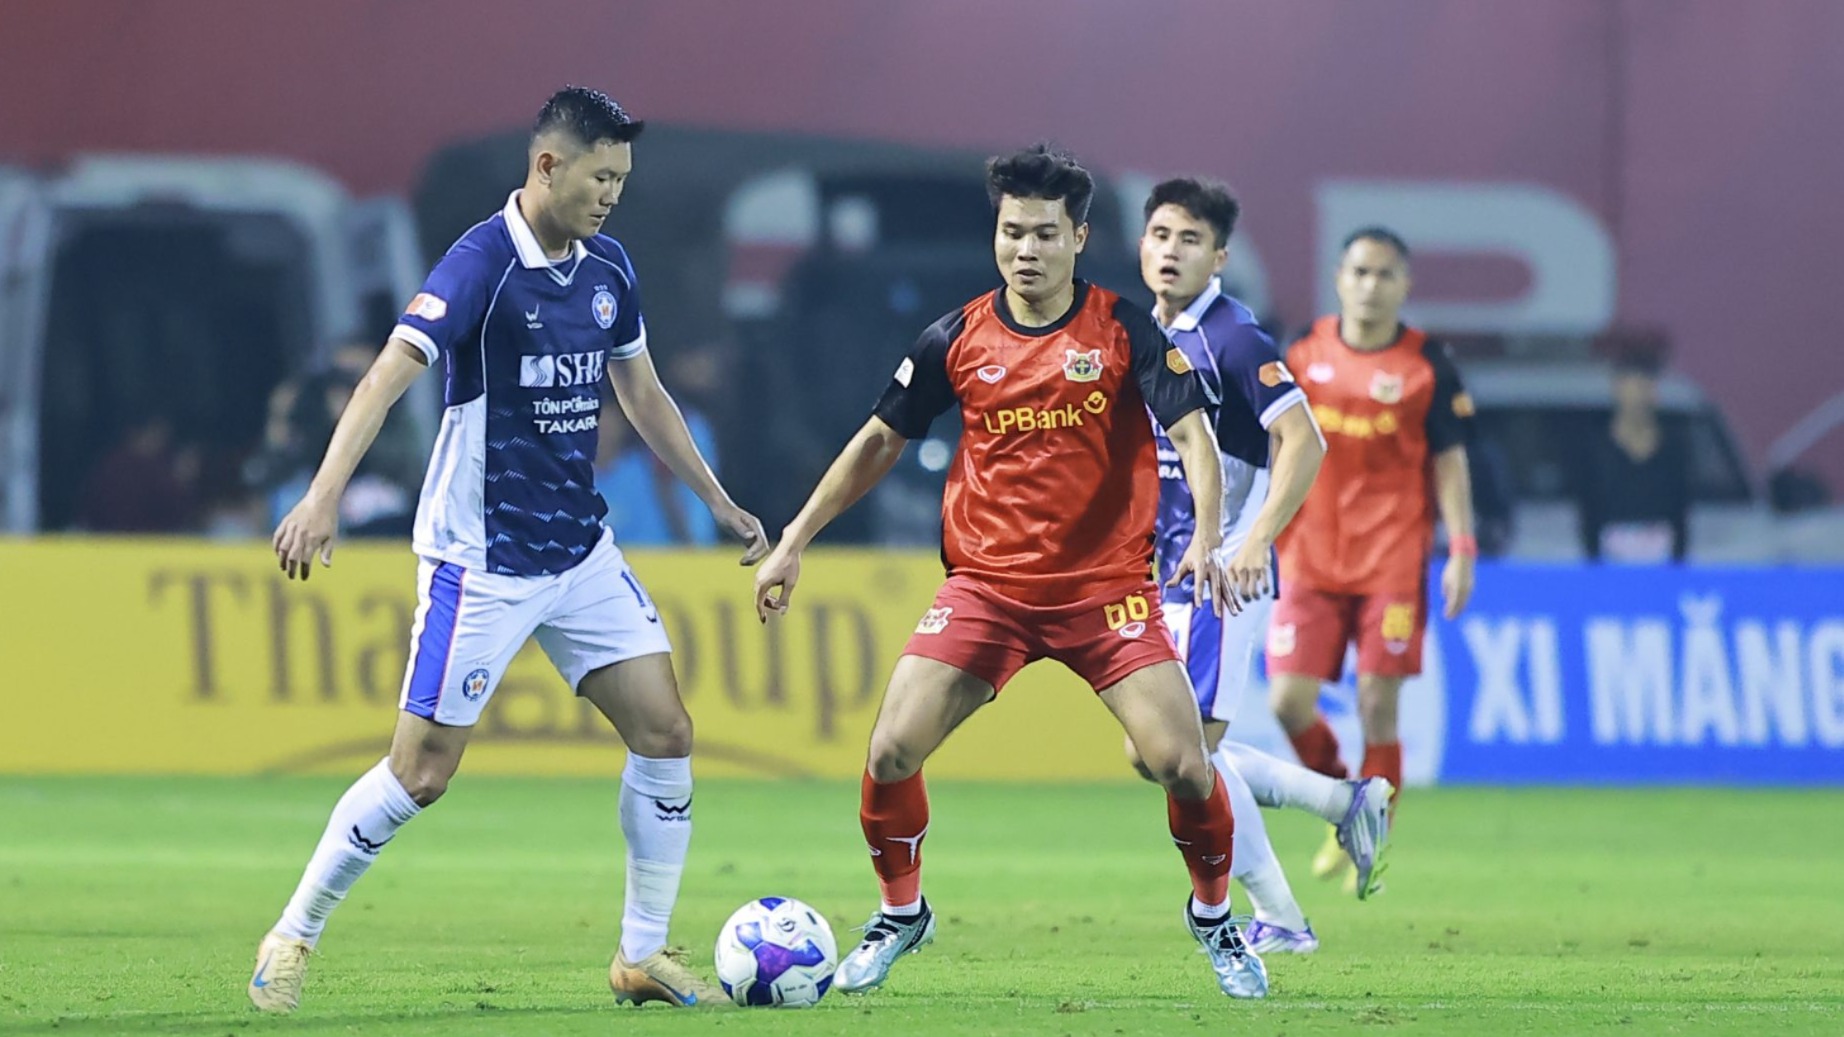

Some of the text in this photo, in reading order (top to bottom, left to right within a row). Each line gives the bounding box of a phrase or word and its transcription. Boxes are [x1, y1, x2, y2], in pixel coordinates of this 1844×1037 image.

[532, 397, 561, 415] TÔN
[983, 403, 1083, 435] LPBank
[1103, 594, 1149, 631] 66
[1464, 615, 1565, 744] XI
